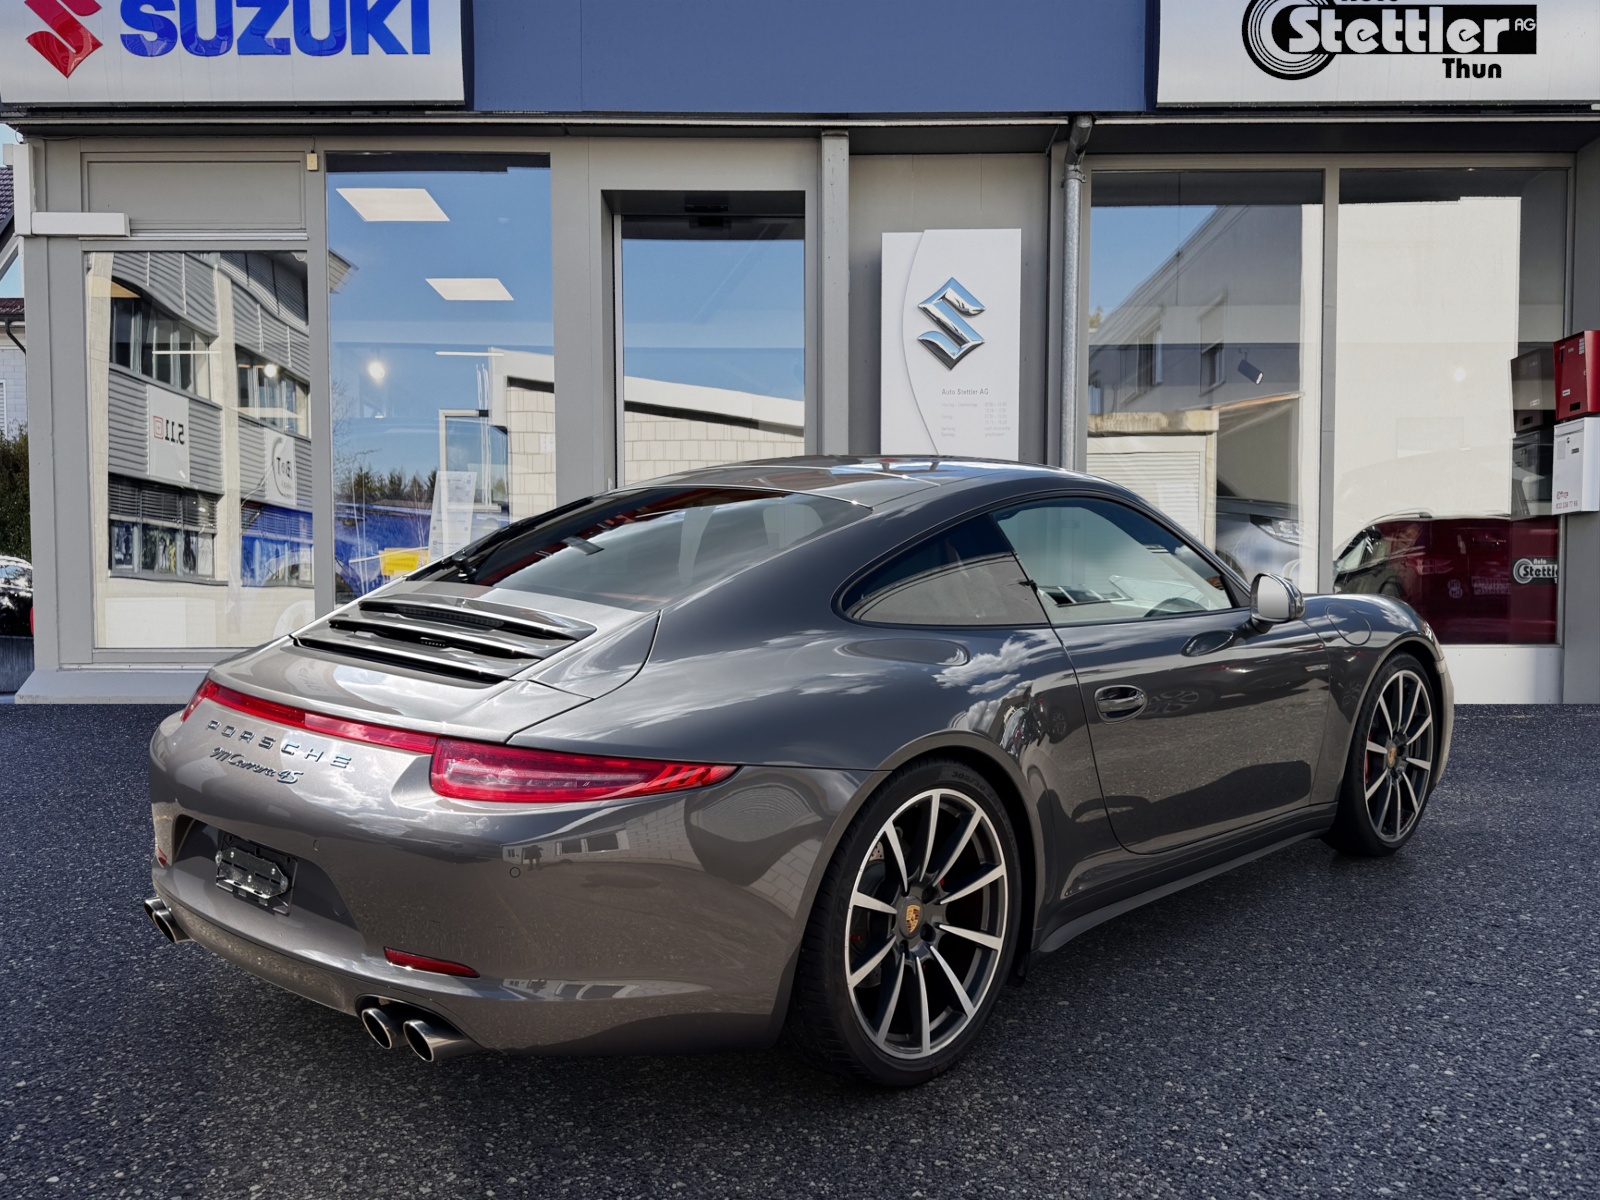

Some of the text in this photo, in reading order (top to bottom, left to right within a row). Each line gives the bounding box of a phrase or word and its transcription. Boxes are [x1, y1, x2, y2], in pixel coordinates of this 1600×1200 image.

[120, 0, 430, 57] SUZUKI
[1289, 6, 1536, 53] Stettler AG
[1442, 58, 1502, 78] Thun
[1522, 565, 1557, 577] Stettl
[206, 720, 352, 769] PORSCHE
[276, 769, 304, 785] 4S
